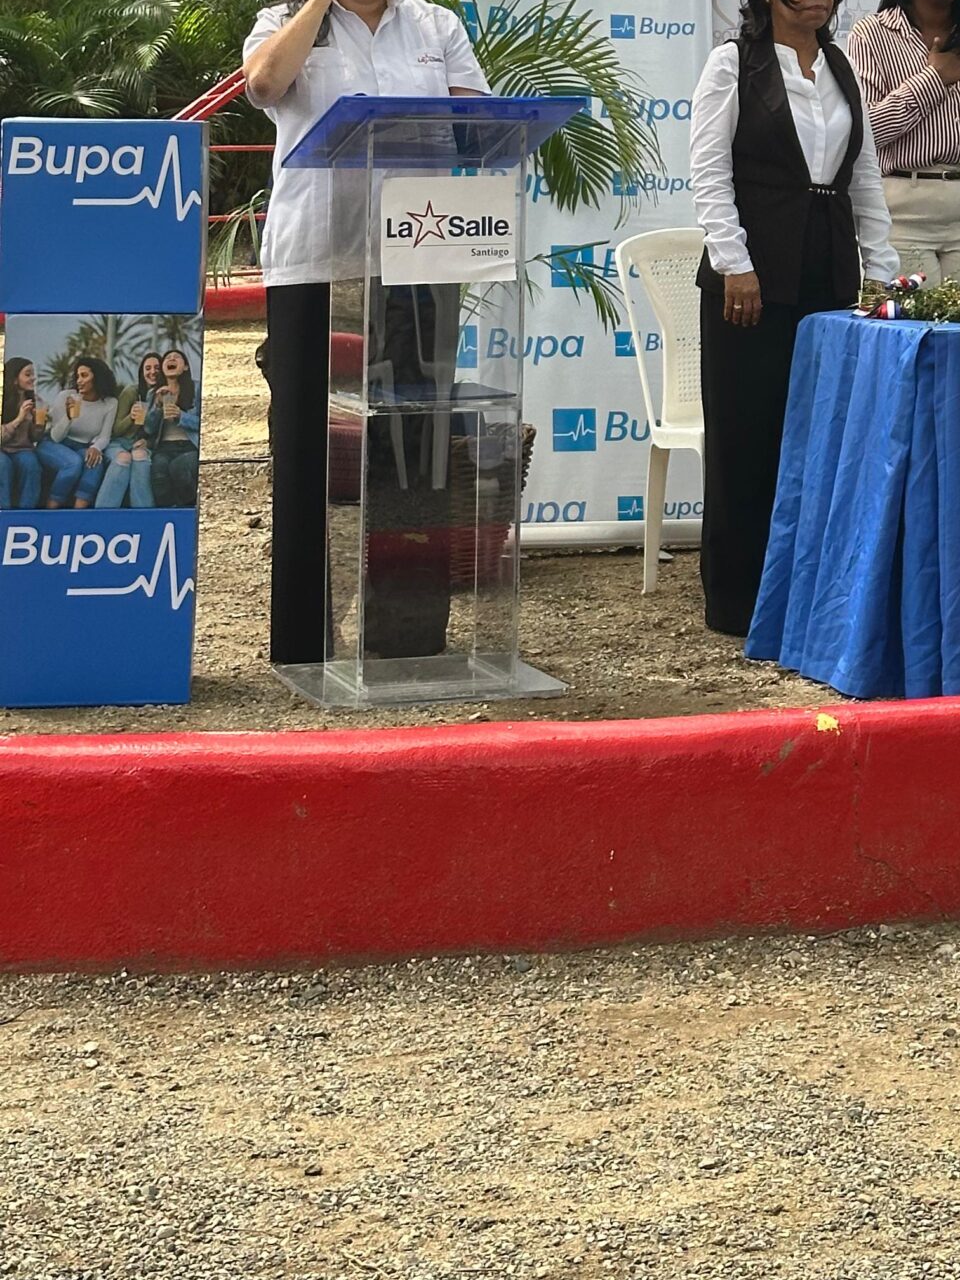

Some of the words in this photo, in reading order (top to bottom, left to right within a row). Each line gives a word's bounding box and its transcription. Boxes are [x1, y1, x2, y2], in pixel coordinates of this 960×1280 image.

[640, 17, 696, 39] Bupa
[8, 136, 144, 183] Bupa
[386, 218, 412, 238] La
[448, 216, 510, 238] Salle
[470, 247, 510, 258] Santiago
[487, 328, 584, 365] Bupa
[605, 411, 650, 441] Bu
[2, 526, 140, 573] Bupa
